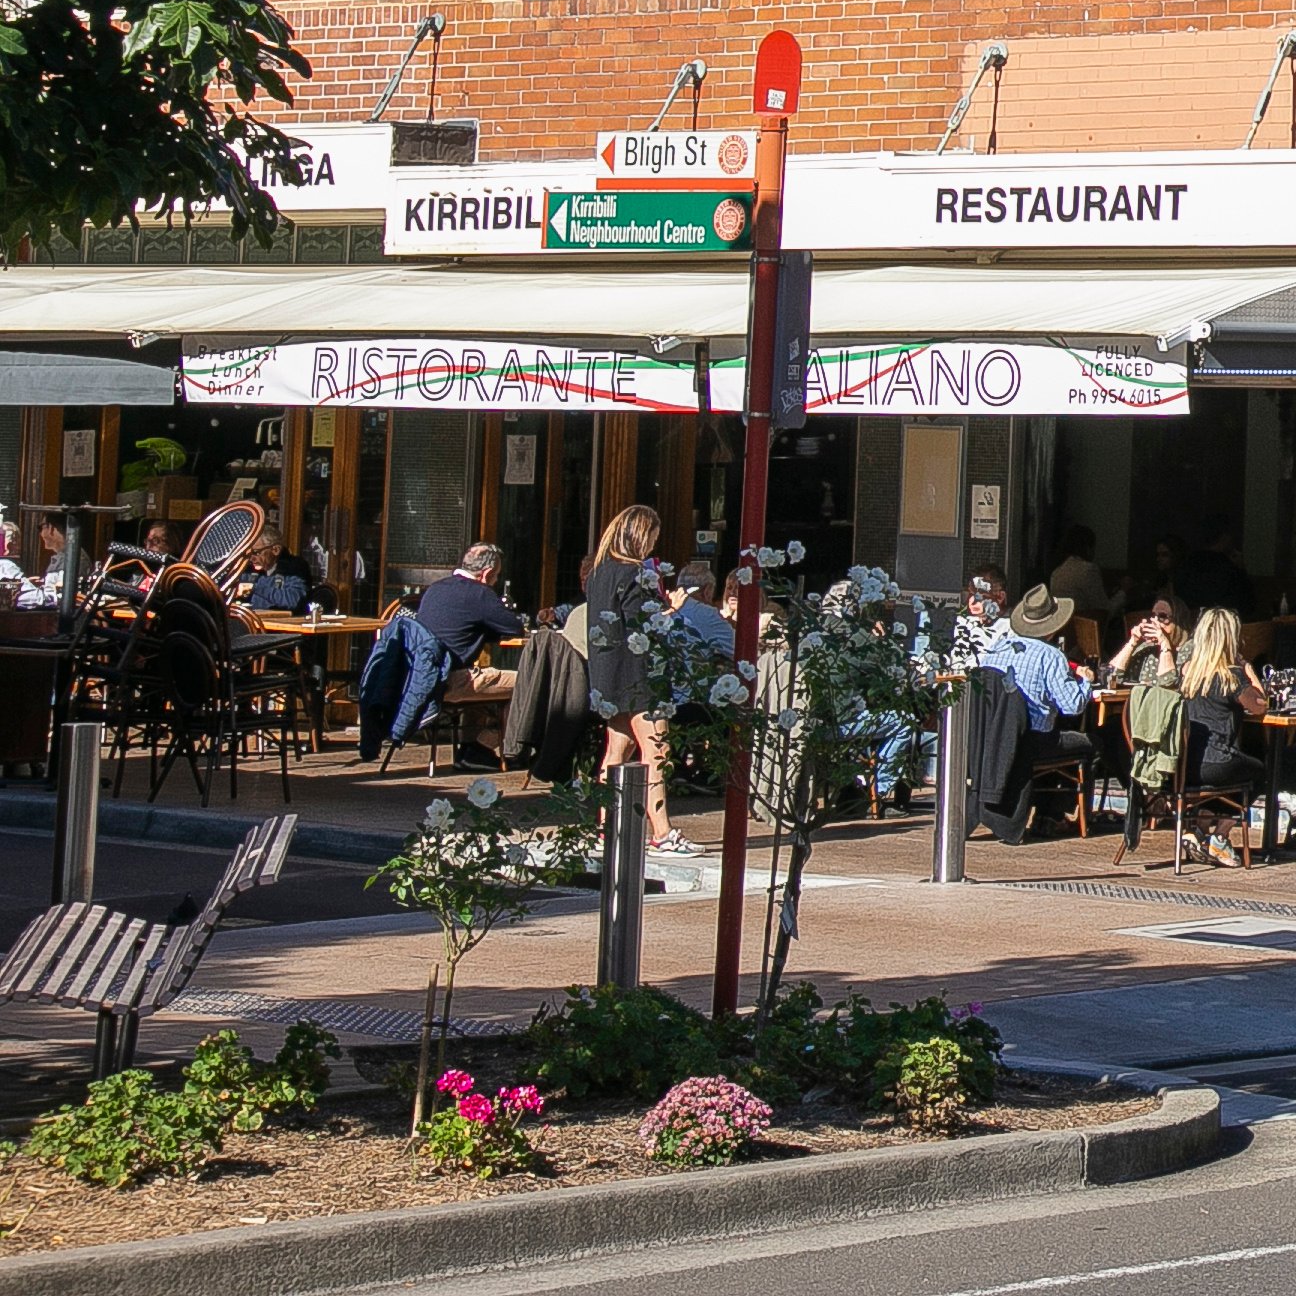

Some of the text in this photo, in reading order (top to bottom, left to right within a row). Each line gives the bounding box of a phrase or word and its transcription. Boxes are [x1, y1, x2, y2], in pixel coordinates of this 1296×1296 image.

[624, 135, 707, 173] Bligh St
[571, 195, 618, 218] Kirribilli
[934, 184, 1188, 223] RESTAURANT
[569, 220, 706, 248] Neighbourhood Centre
[1096, 345, 1142, 360] FULLY
[212, 363, 261, 379] Lunch
[310, 347, 638, 403] RISTORANTE
[208, 380, 265, 396] Dinner
[1068, 388, 1087, 404] Ph
